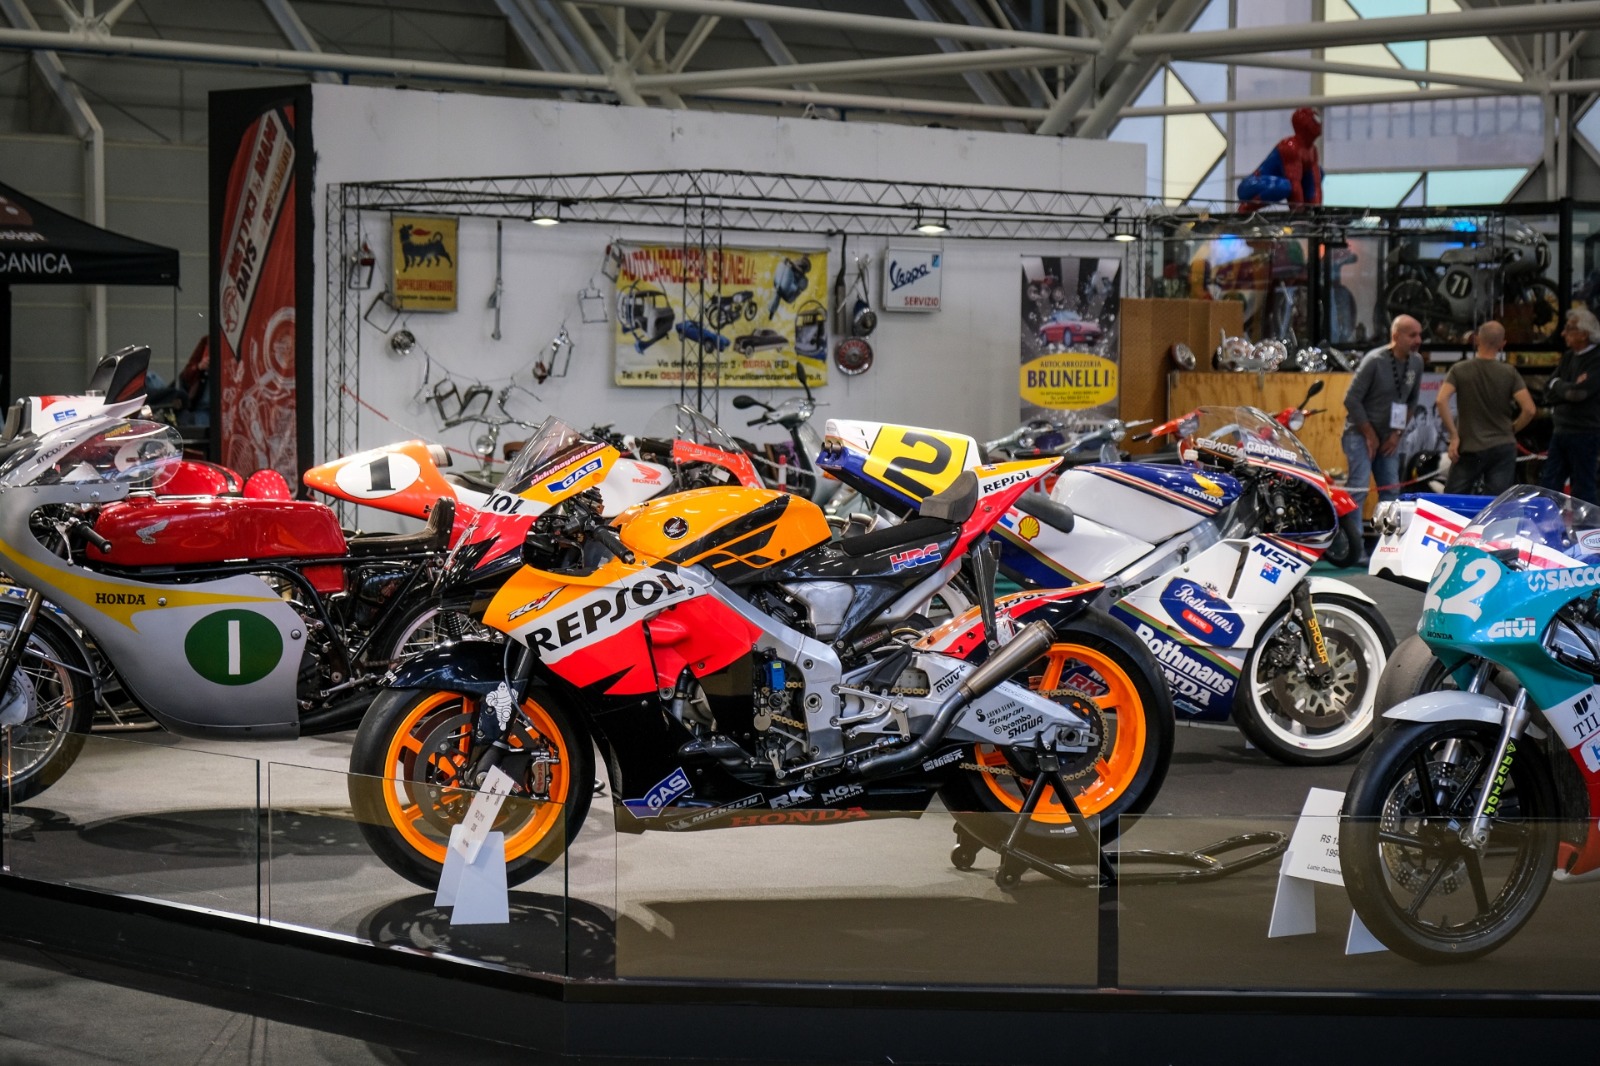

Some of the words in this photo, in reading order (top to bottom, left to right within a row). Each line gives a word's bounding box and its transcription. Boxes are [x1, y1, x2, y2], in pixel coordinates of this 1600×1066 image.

[889, 260, 931, 291] Vespa
[1450, 273, 1470, 297] 71
[904, 296, 939, 307] SERVIZIO
[1027, 370, 1109, 388] BRUNELLI
[1246, 441, 1298, 461] GARDNER
[361, 455, 396, 492] 1
[562, 461, 601, 489] GAS
[883, 431, 953, 497] 2
[632, 478, 662, 486] HONDA
[983, 470, 1033, 494] REPSOL
[1183, 485, 1225, 506] HONDA
[890, 543, 943, 573] HRC
[1252, 542, 1302, 573] NSR
[95, 592, 146, 606] HONDA
[1423, 551, 1502, 622] 22
[524, 573, 685, 658] REPSOL
[1174, 583, 1235, 634] Rothmans
[1187, 613, 1208, 629] RACING
[1308, 617, 1329, 665] SHOWA
[1426, 630, 1454, 641] HONDA
[1487, 619, 1536, 639] GIVI
[228, 620, 241, 675] 1
[1135, 623, 1234, 694] Rothmans
[1070, 673, 1106, 697] RK
[1159, 667, 1211, 707] NDA
[1002, 714, 1032, 731] brembo
[1007, 714, 1044, 739] SHOWA
[647, 774, 688, 811] GAS
[769, 783, 814, 810] RK
[820, 783, 863, 800] NGK
[1483, 755, 1513, 815] DUNLOP
[691, 795, 758, 823] MICHELIN
[729, 806, 871, 828] HONDA
[1320, 834, 1332, 844] RS
[1325, 848, 1340, 858] 199
